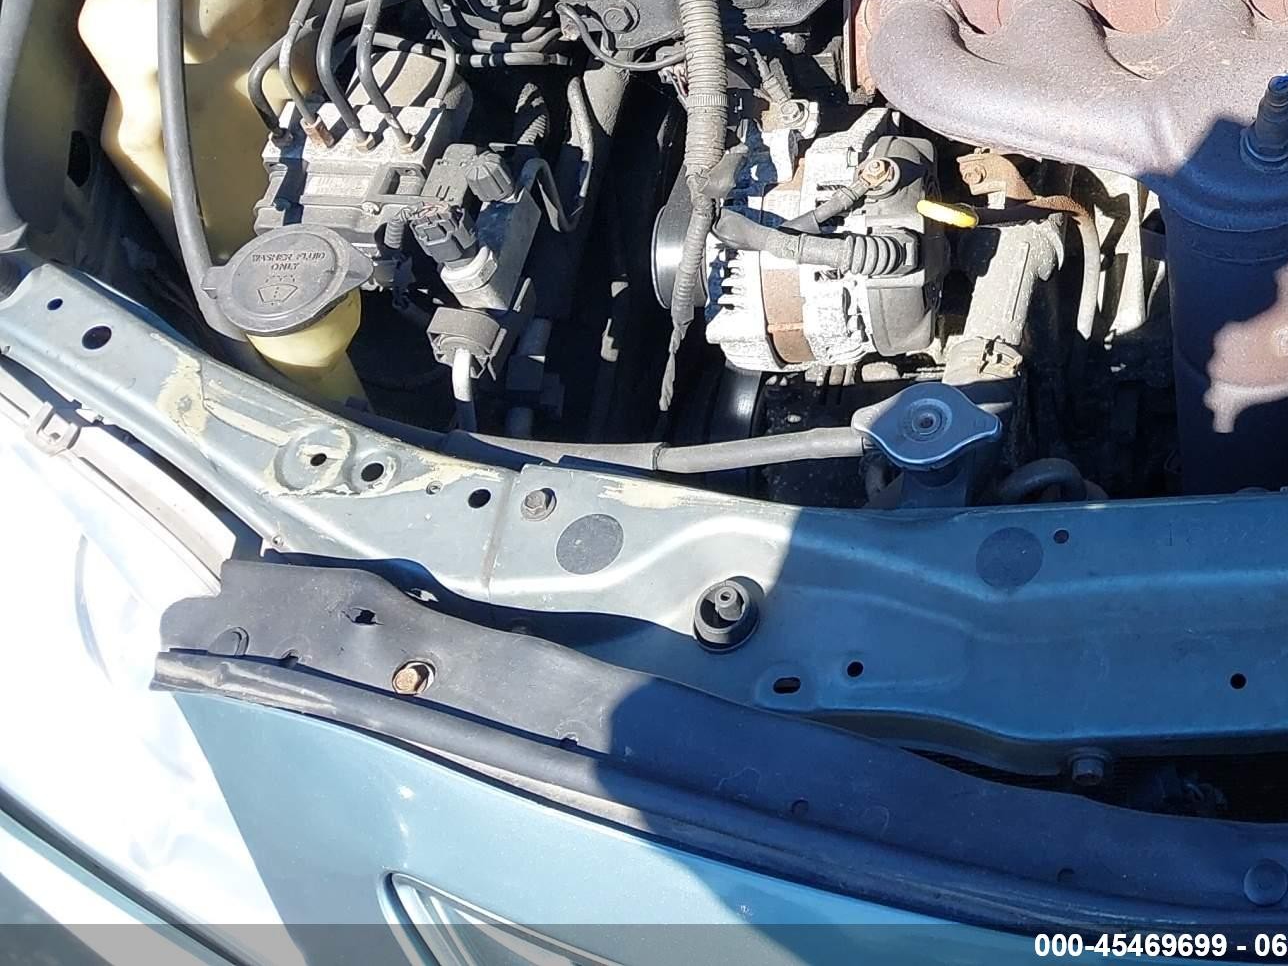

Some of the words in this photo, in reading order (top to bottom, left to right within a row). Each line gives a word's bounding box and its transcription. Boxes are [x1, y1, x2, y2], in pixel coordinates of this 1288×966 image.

[252, 253, 293, 263] WASHER
[296, 252, 326, 261] FLUID
[271, 263, 300, 271] ONLY
